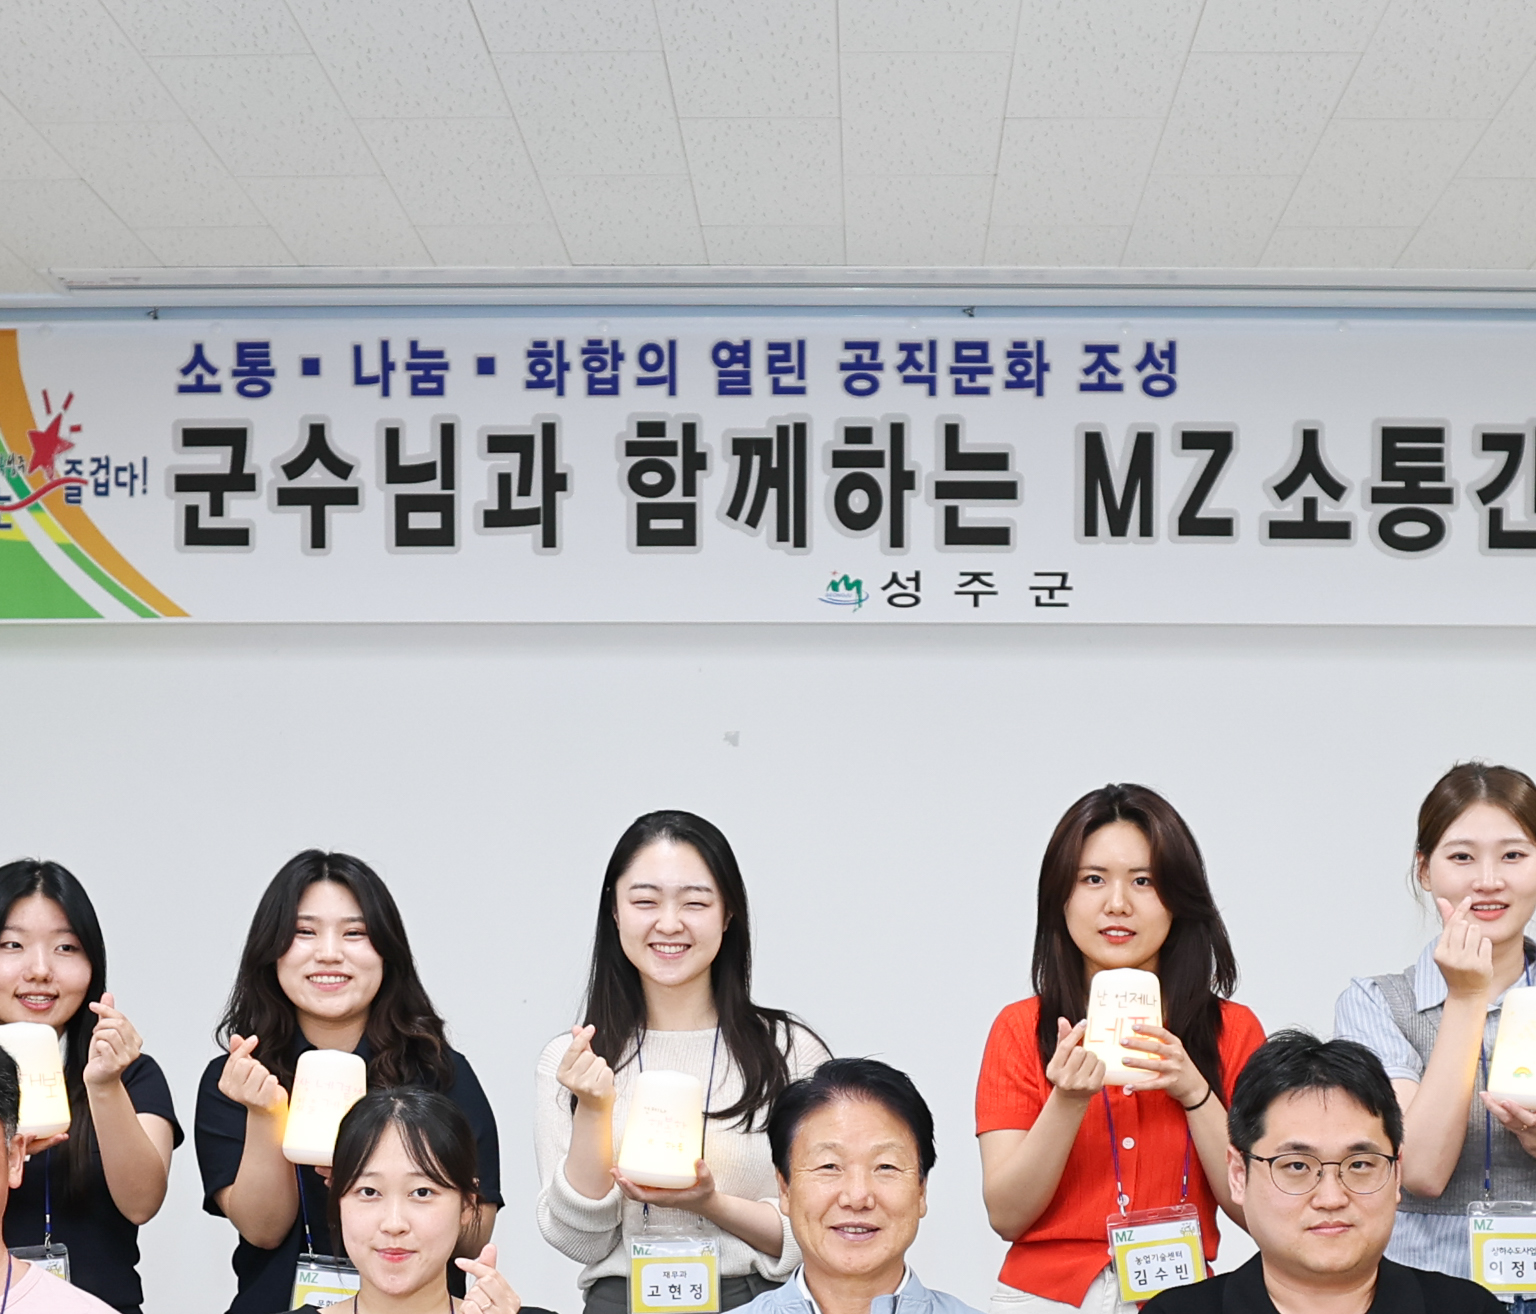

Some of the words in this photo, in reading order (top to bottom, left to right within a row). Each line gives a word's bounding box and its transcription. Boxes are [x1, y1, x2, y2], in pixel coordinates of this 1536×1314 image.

[177, 341, 276, 398] 소통
[353, 340, 450, 397] 나눔
[525, 340, 677, 397] 화합의
[711, 340, 807, 396] 열린
[839, 340, 1050, 397] 공직문화
[1079, 341, 1177, 397] 조성
[64, 455, 148, 505] 즐겁다!
[174, 421, 568, 550] 군수님과
[624, 420, 1018, 549] 함께하는
[1115, 989, 1158, 1009] 언제나
[1473, 1219, 1494, 1231] MZ
[1114, 1230, 1135, 1243] MZ
[633, 1244, 652, 1256] MZ
[1135, 1251, 1183, 1266] 농업기술센터
[299, 1271, 319, 1284] MZ
[662, 1270, 688, 1279] 재무과
